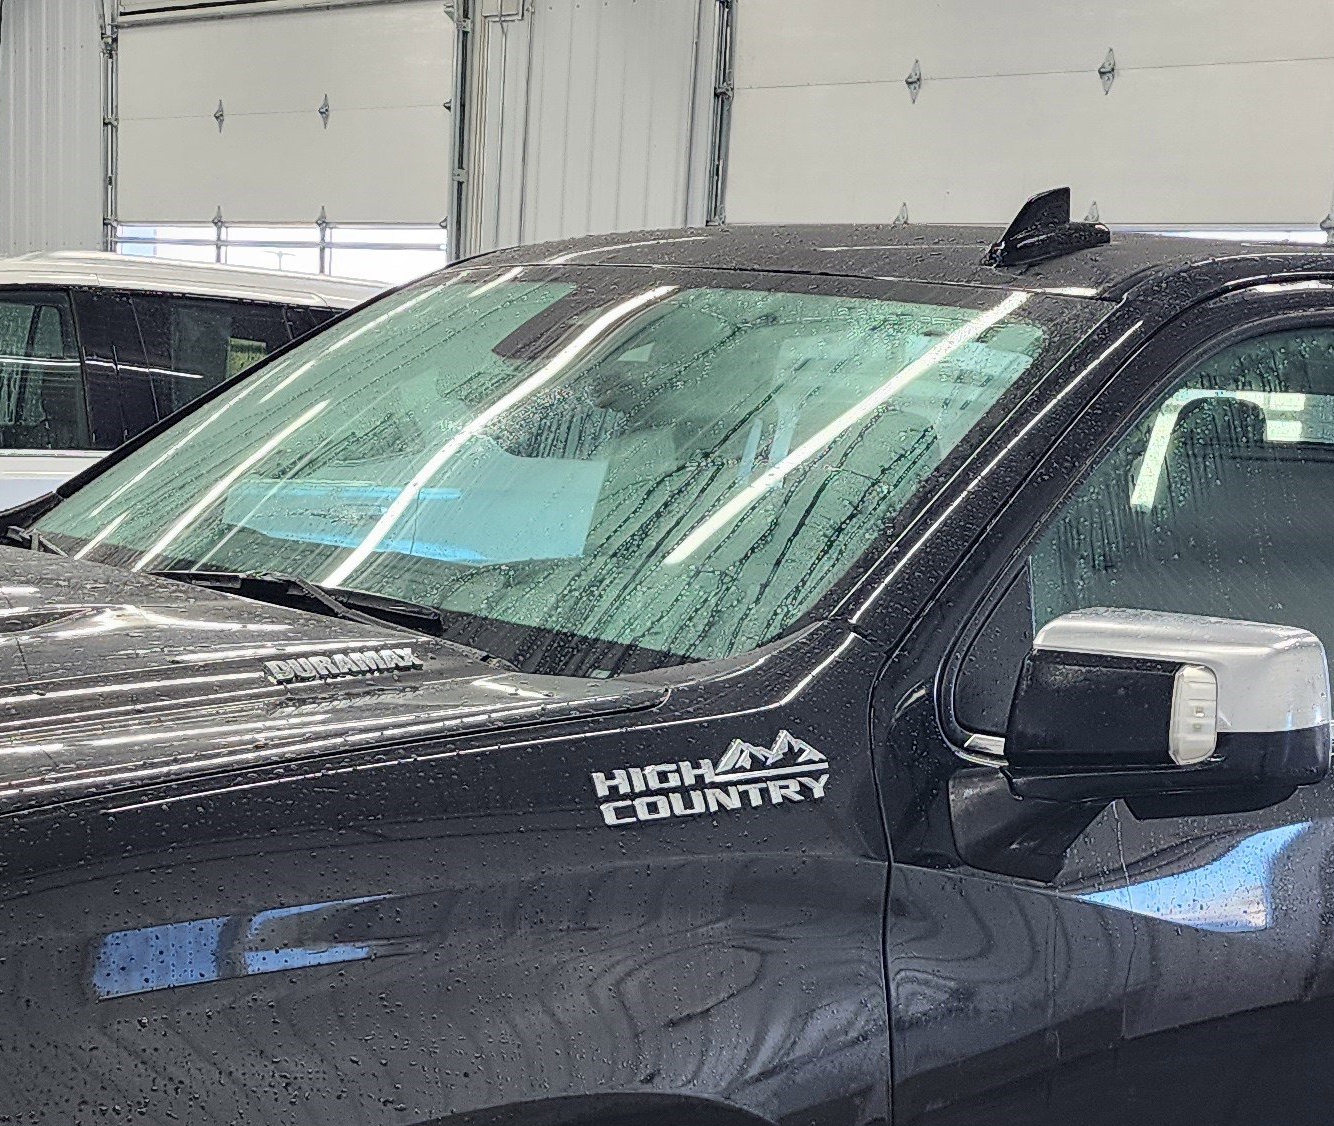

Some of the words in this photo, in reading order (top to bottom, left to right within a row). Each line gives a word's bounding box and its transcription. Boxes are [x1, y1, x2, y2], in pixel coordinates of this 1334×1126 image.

[262, 646, 425, 685] DURAMAX
[591, 758, 717, 798] HIGH
[600, 774, 830, 826] COUNTRY
